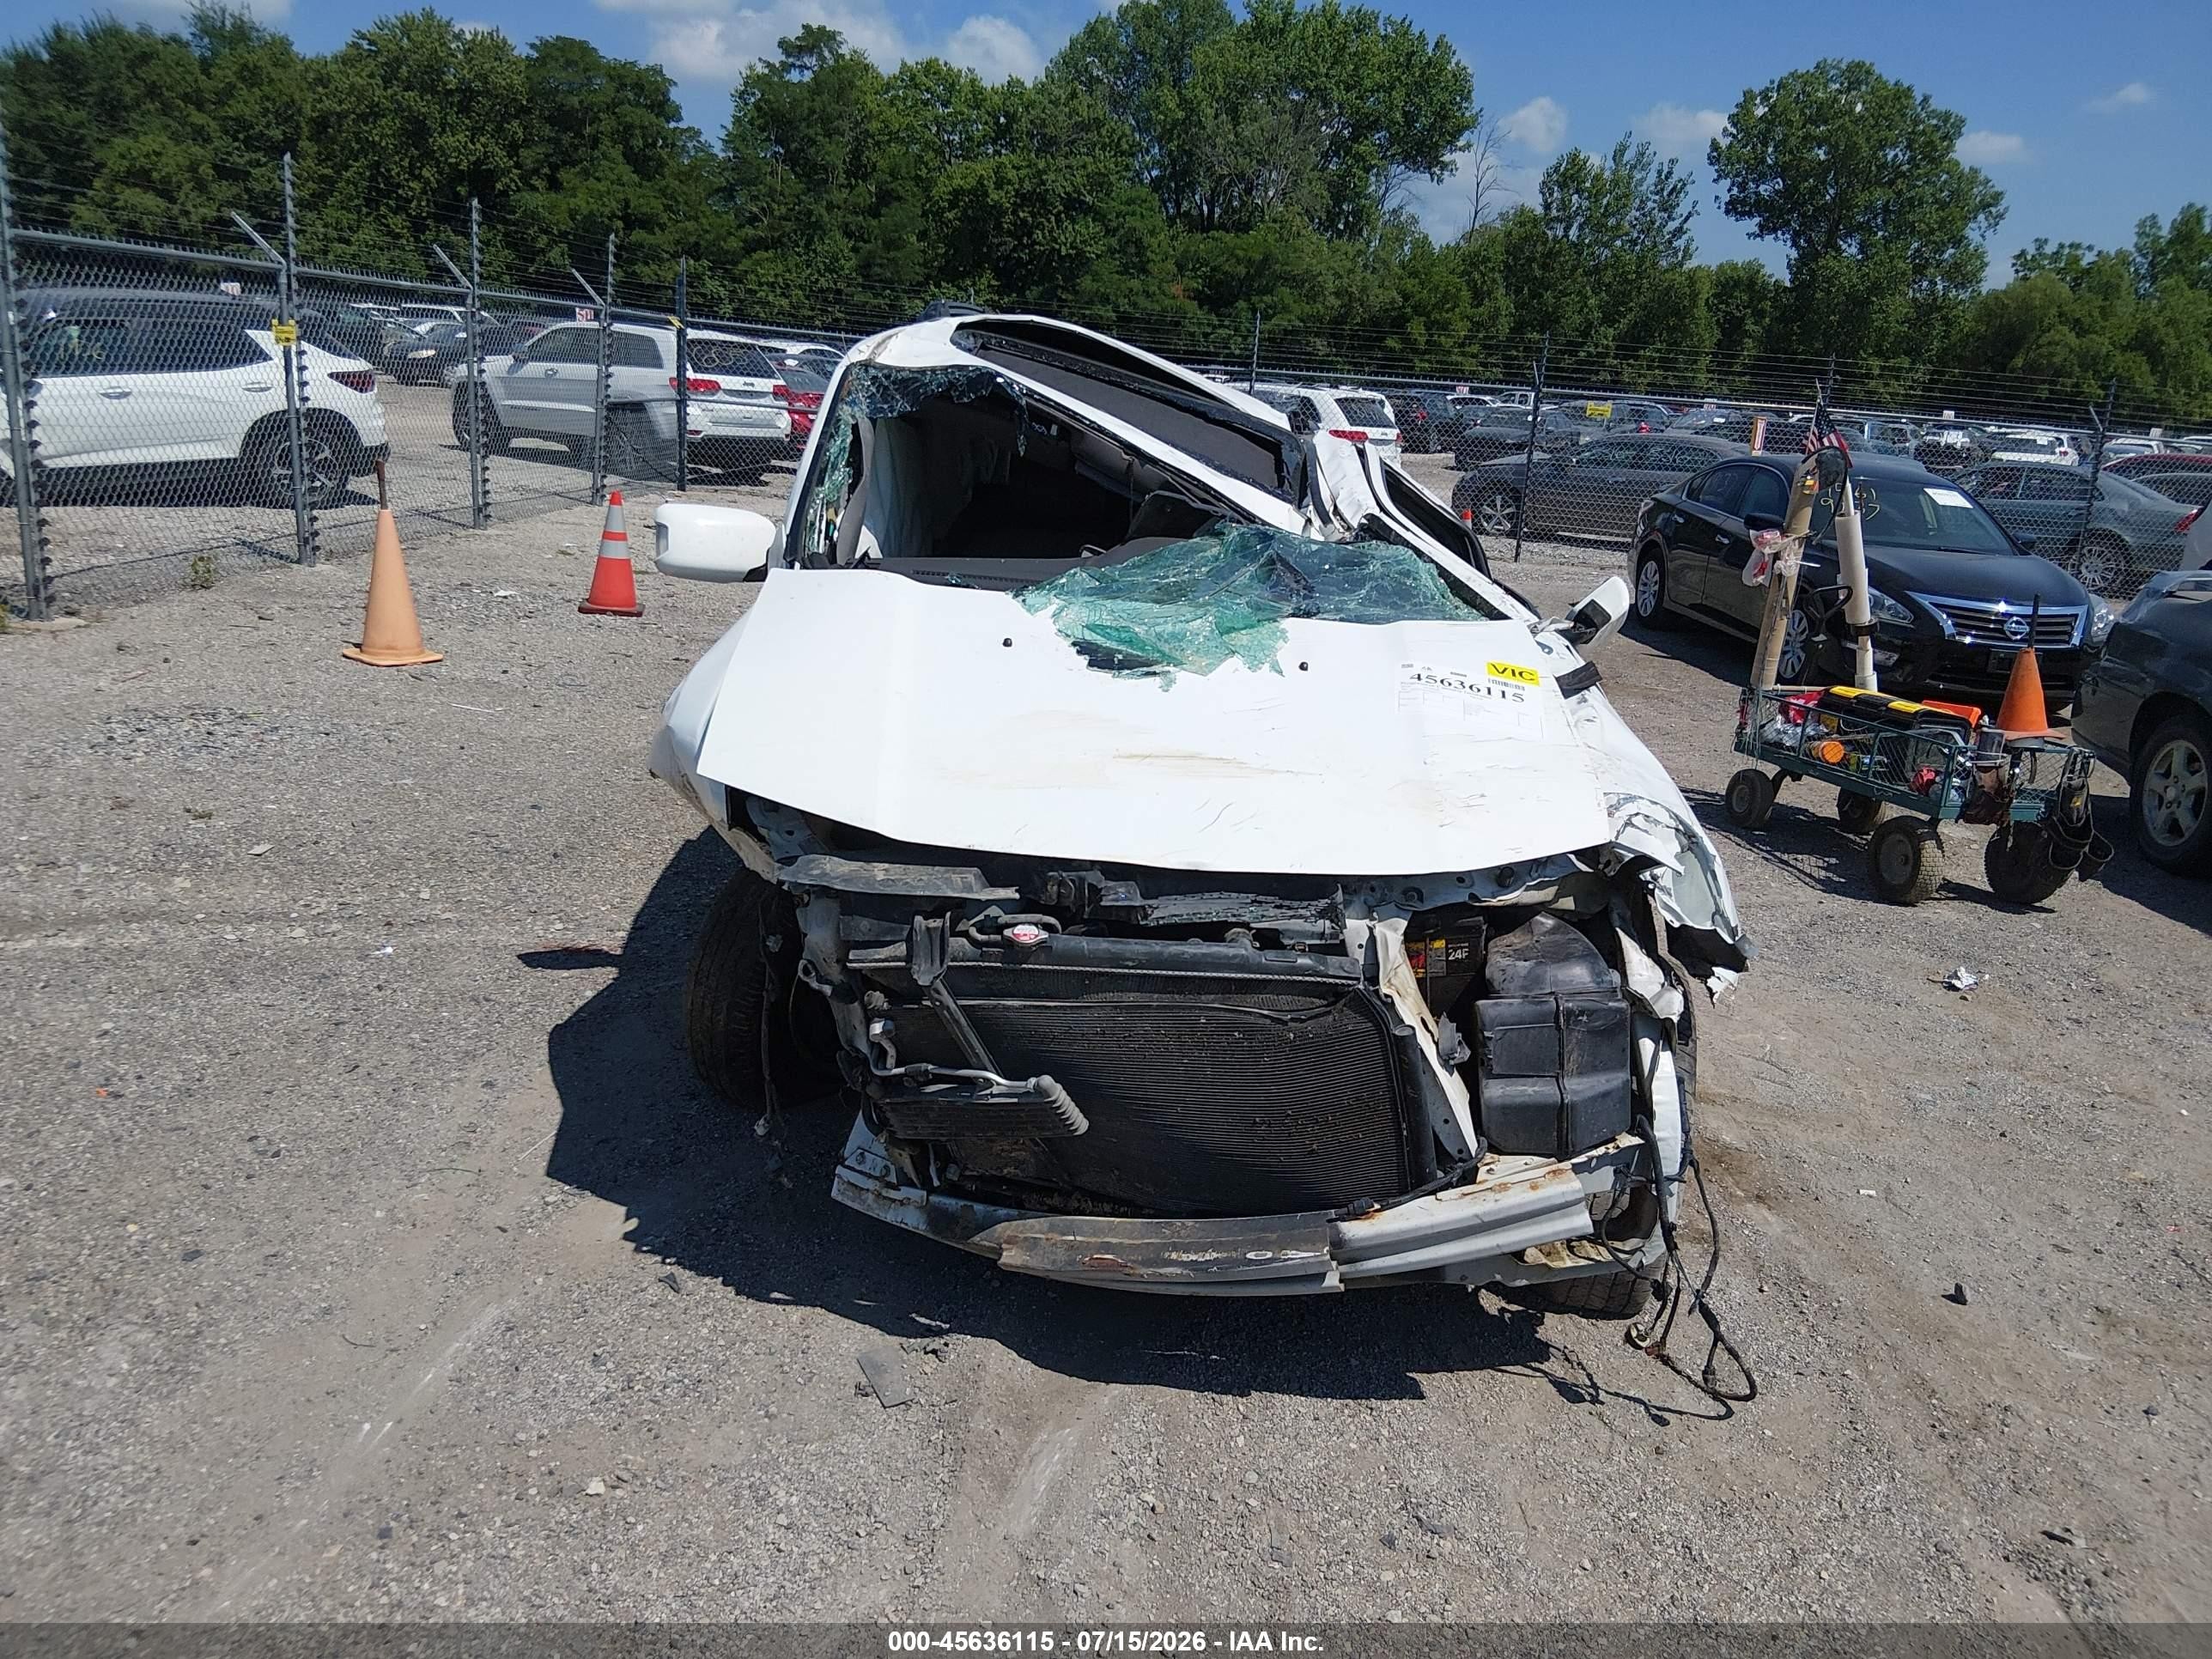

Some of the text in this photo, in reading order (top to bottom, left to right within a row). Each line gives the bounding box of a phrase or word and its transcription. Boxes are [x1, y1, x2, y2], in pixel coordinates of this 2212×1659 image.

[1490, 662, 1536, 682] VIC
[1409, 673, 1526, 703] 45636115
[1448, 948, 1469, 960] 24F
